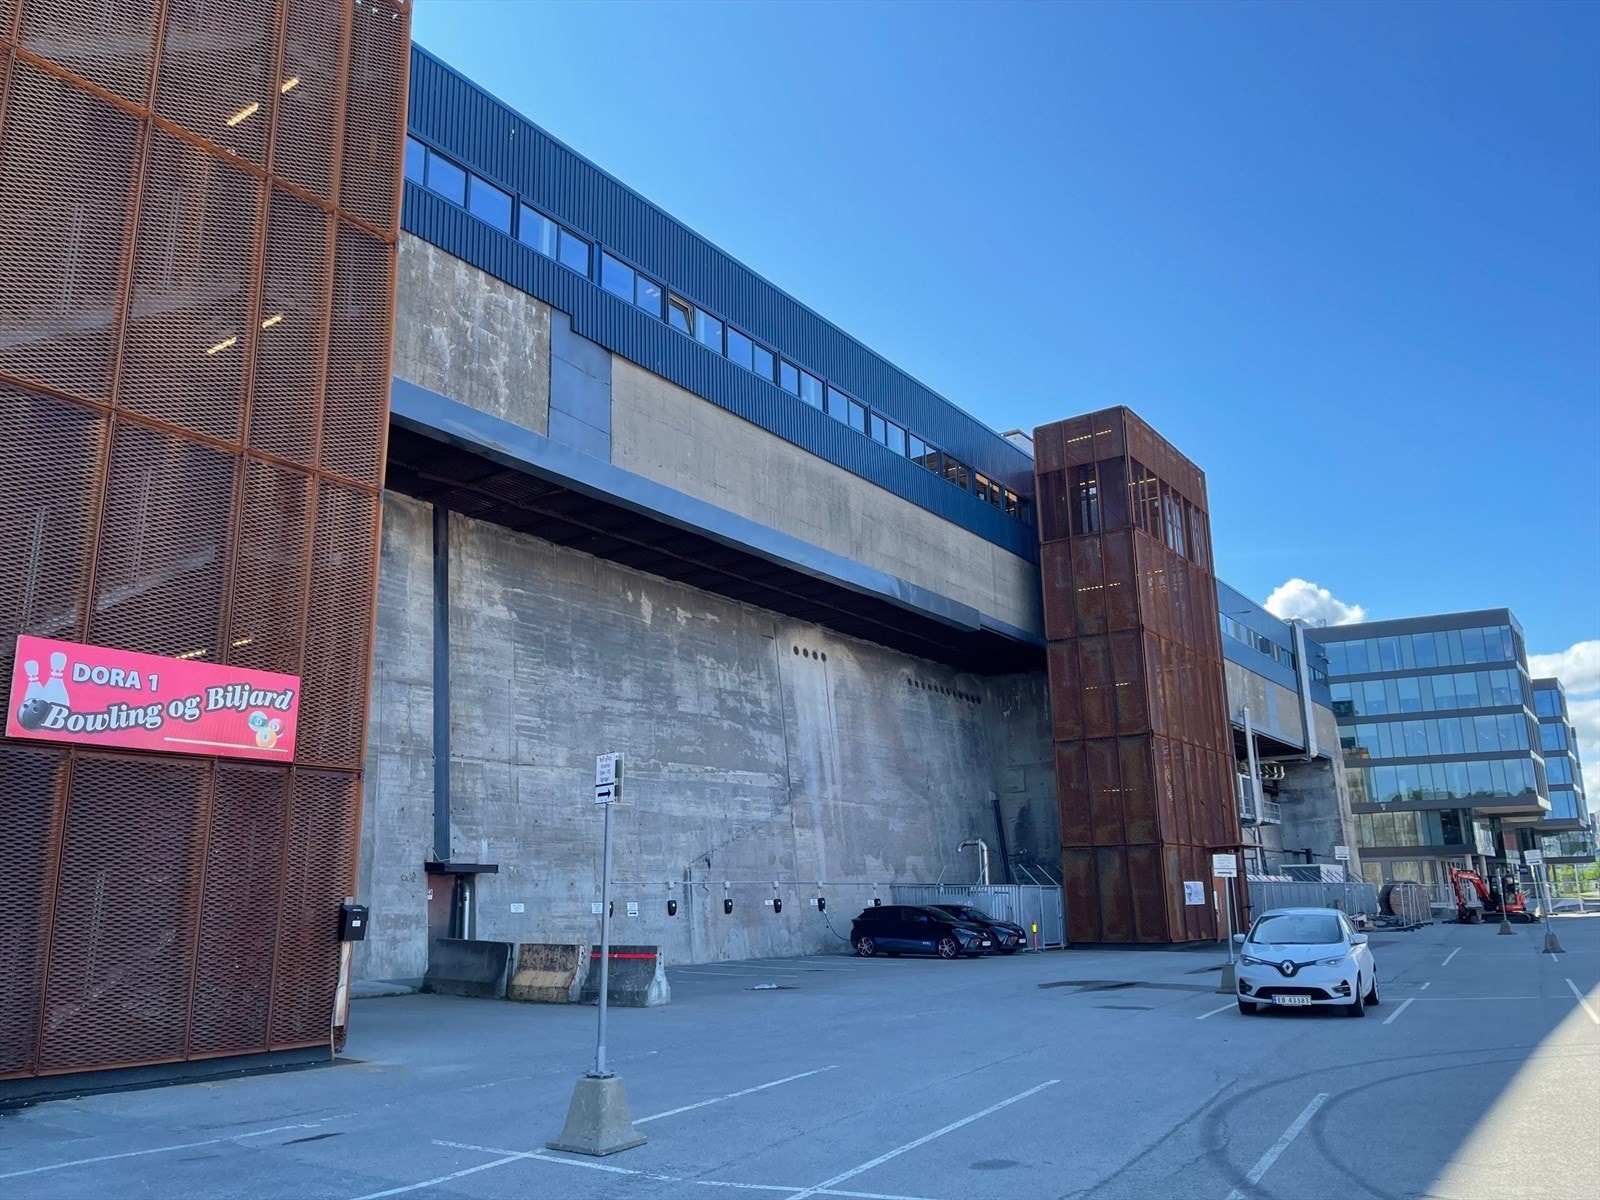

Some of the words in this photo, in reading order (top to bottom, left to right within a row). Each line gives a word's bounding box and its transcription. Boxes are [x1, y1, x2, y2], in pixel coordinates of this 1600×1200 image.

[72, 662, 141, 689] DORA
[148, 674, 159, 691] 1
[42, 704, 163, 732] Bowling
[168, 697, 201, 720] og
[206, 685, 293, 710] Biljard
